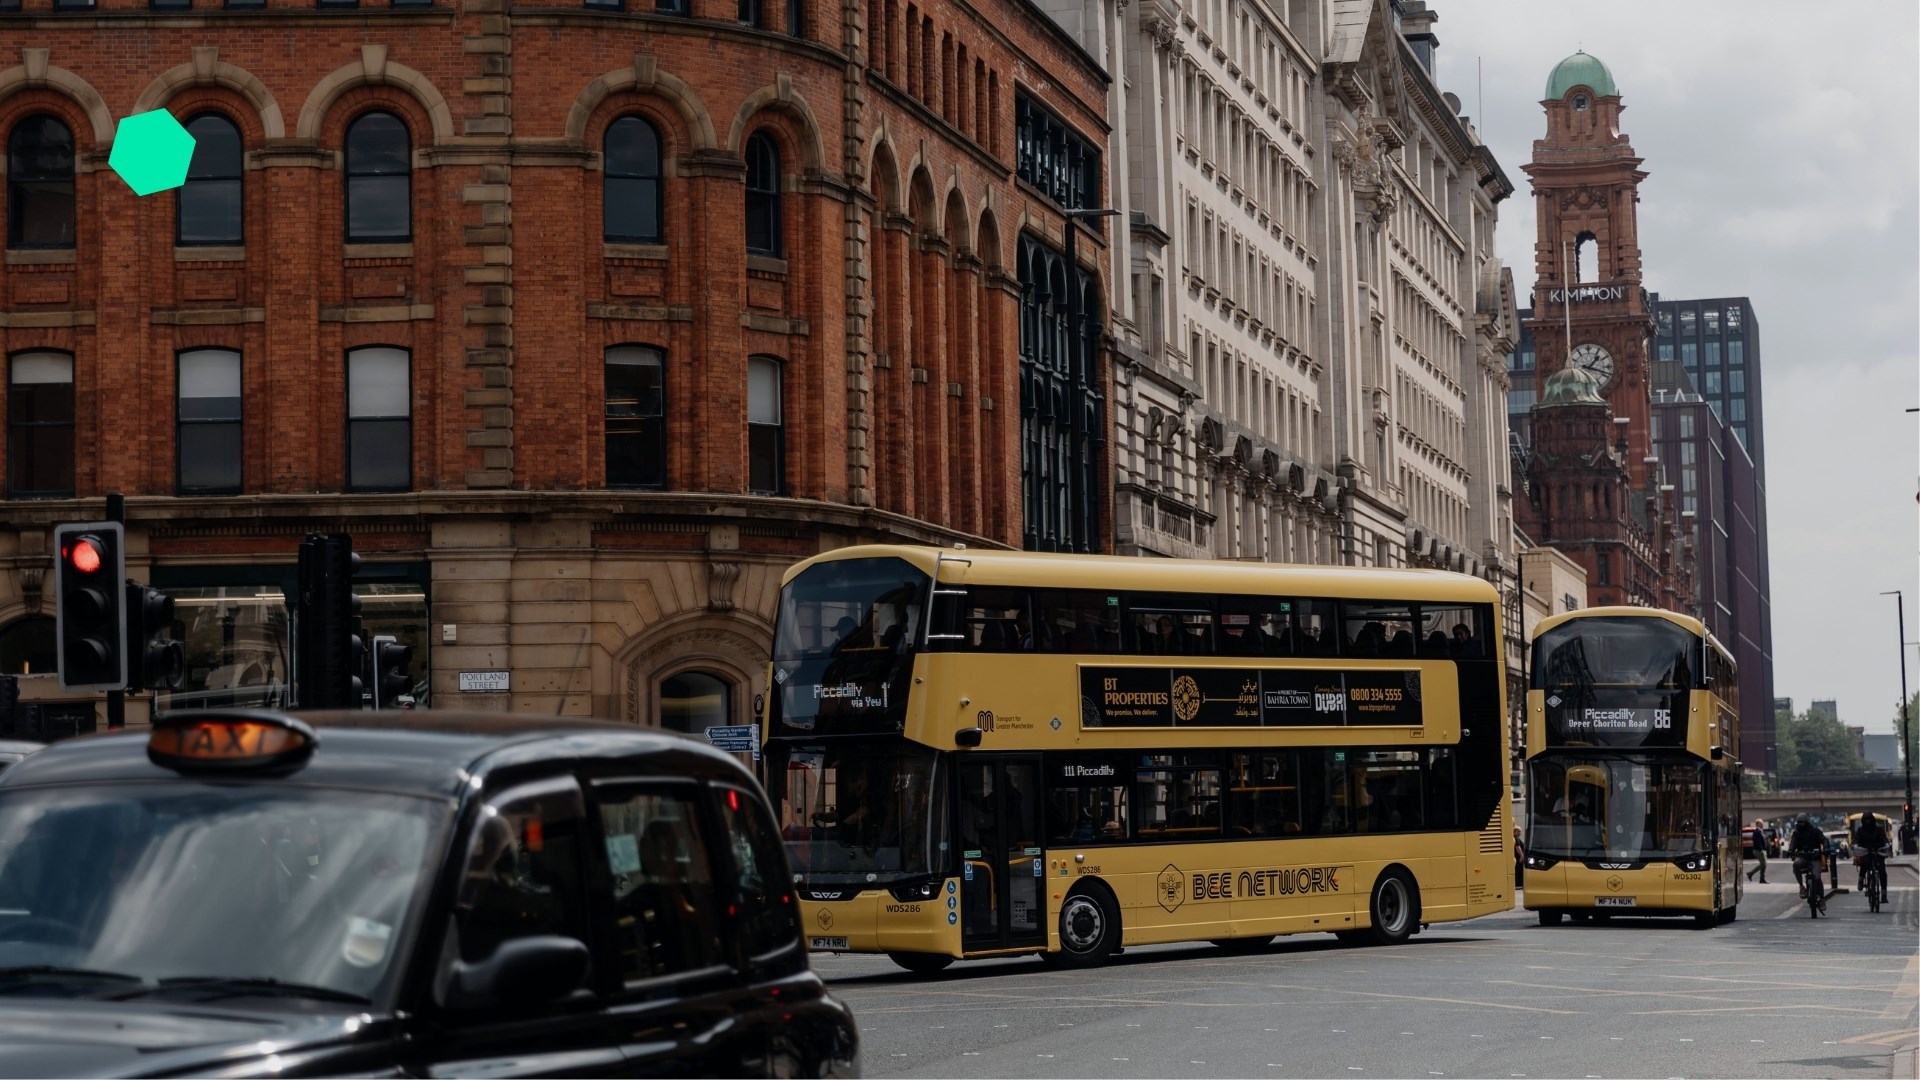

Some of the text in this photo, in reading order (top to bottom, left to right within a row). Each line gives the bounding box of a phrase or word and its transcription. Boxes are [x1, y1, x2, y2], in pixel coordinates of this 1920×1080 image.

[1550, 287, 1623, 303] KIMPTON
[462, 673, 507, 681] PORTLAND
[468, 681, 501, 689] STREET
[1104, 677, 1118, 691] BT
[814, 682, 863, 699] Piccadilly
[1350, 688, 1402, 701] 0800 334 5555
[851, 696, 882, 708] via Yew
[1104, 692, 1169, 705] PROPERTIES
[1267, 695, 1309, 705] BAHRIA TOWN
[1315, 693, 1347, 713] DUBAI
[996, 715, 1015, 723] Transport
[1585, 708, 1635, 719] Piccadilly
[1654, 709, 1671, 729] 86
[1568, 719, 1647, 728] Upper Chorlton Road
[176, 727, 267, 755] TAXI
[1064, 764, 1115, 777] 111 Piccadilly
[1077, 866, 1101, 875] WDS286
[1193, 867, 1338, 900] BEE NETWORK
[1619, 897, 1633, 905] NUK
[886, 905, 921, 913] WDS286
[813, 938, 847, 948] MF74 NRU
